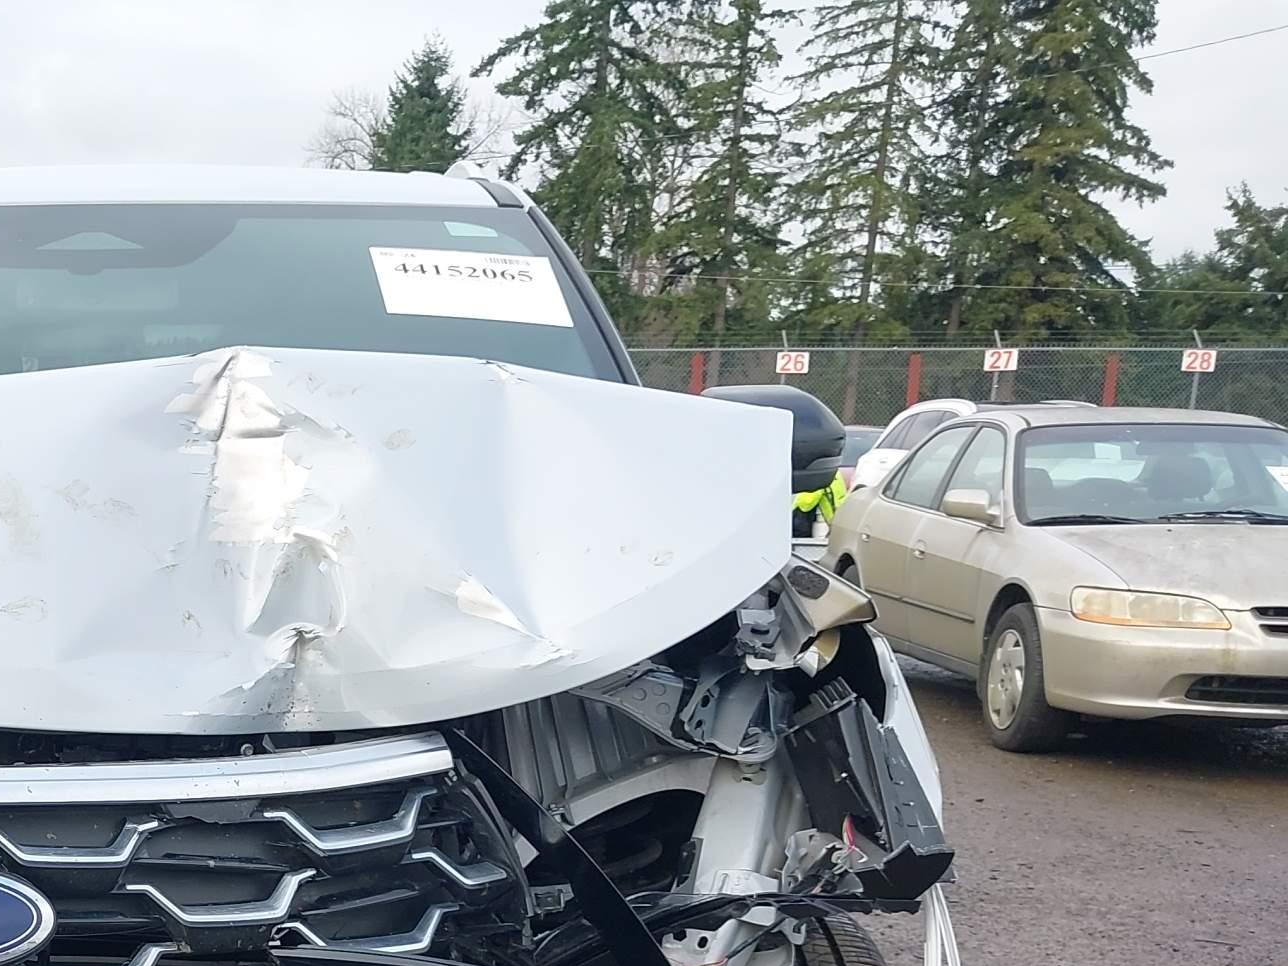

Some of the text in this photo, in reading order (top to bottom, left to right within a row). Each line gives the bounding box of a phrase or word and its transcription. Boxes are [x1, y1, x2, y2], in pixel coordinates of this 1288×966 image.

[394, 263, 534, 282] 44152065
[780, 354, 805, 371] 26
[989, 351, 1013, 369] 27
[1185, 351, 1212, 370] 28
